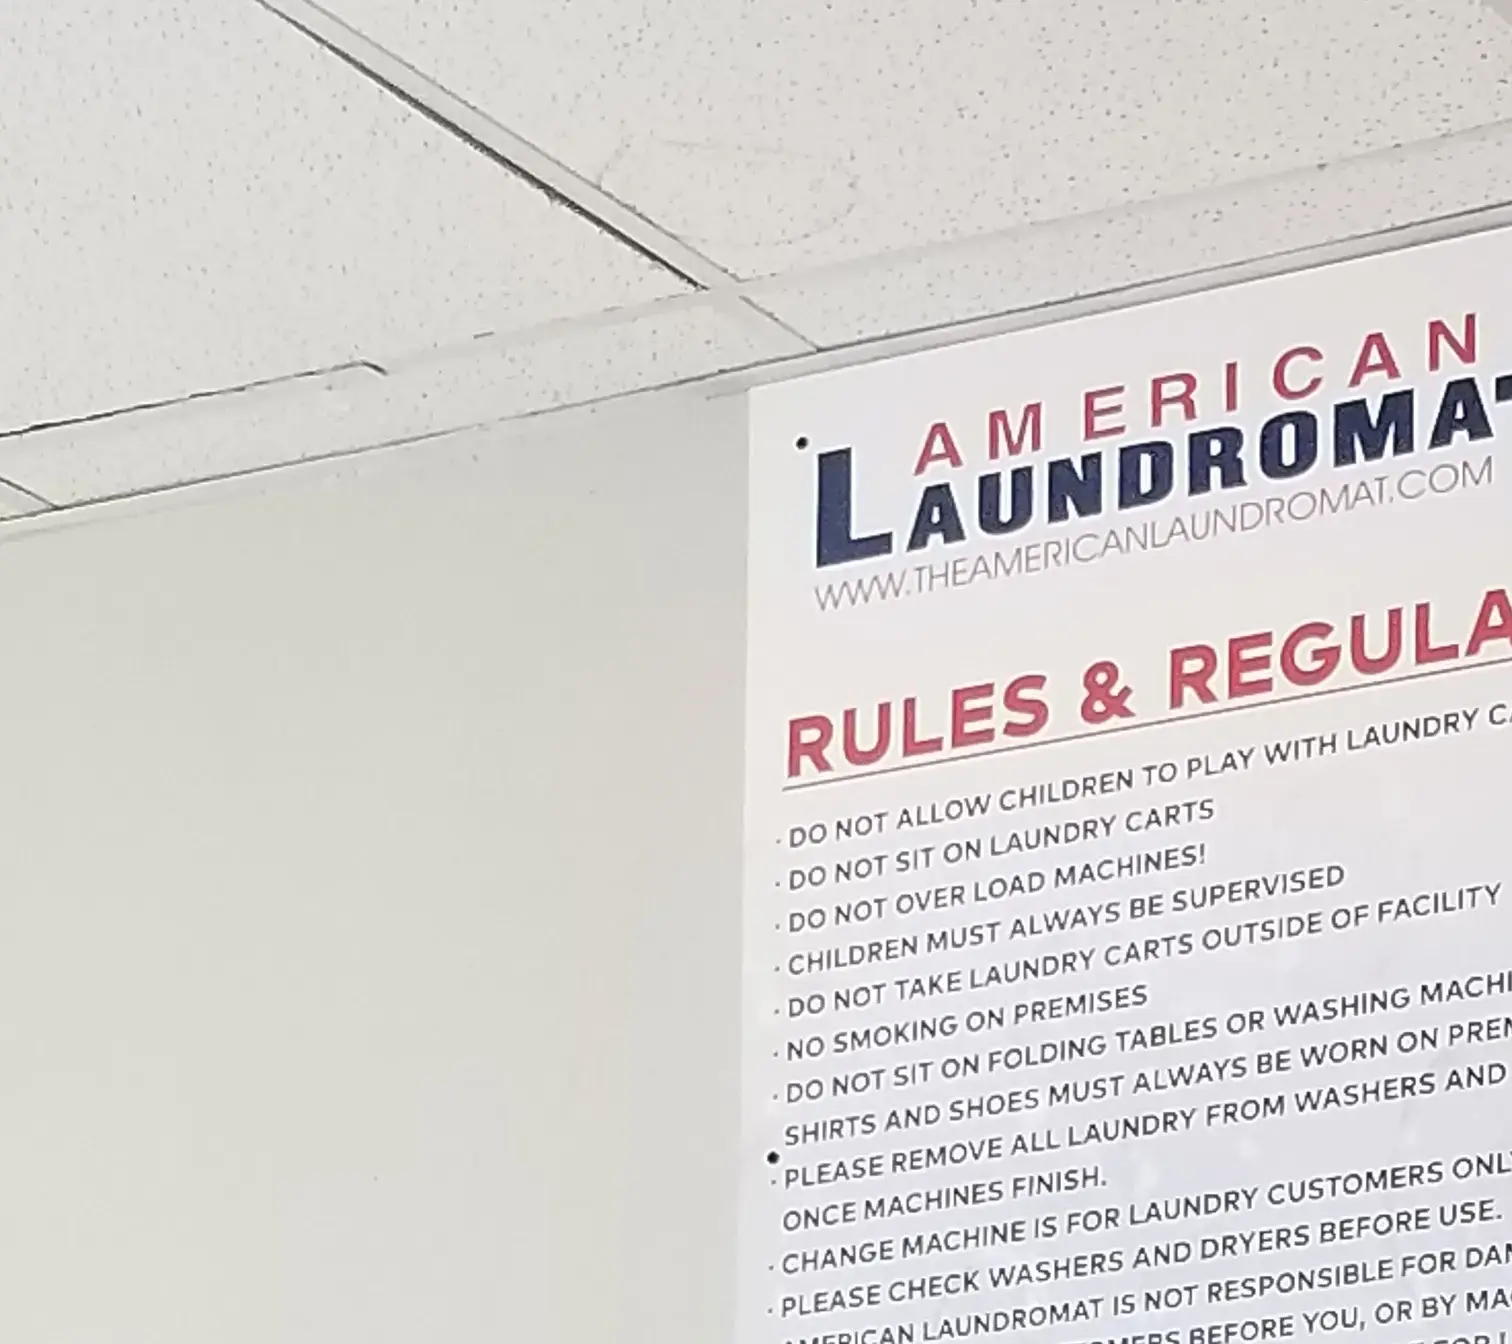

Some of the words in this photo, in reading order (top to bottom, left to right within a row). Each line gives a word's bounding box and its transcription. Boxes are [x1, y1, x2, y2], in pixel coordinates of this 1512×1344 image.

[914, 314, 1477, 475] AMERICAN
[815, 455, 1493, 612] WWW.THEAMERICANLAUNDROMAT.COM
[787, 674, 1049, 777] RULES
[1080, 660, 1131, 725] &
[788, 822, 829, 850] DO
[835, 810, 890, 842] NOT
[895, 792, 993, 831] ALLOW
[998, 767, 1134, 812] CHILDREN
[1140, 761, 1178, 787] TO
[1186, 746, 1256, 781] PLAY
[1262, 732, 1338, 766] WITH
[1346, 706, 1481, 752] LAUNDRY
[787, 934, 919, 977] CHILDREN
[925, 920, 1002, 954] MUST
[1008, 900, 1122, 941] ALWAYS
[1128, 893, 1166, 921] BE
[1171, 864, 1345, 913] SUPERVISED
[788, 907, 827, 934] DO
[833, 896, 889, 927] NOT
[894, 884, 966, 915] OVER
[973, 870, 1046, 903] LOAD
[1053, 842, 1206, 890] MACHINES!
[786, 1035, 826, 1062] NO
[832, 1014, 960, 1055] SMOKING
[964, 1005, 1005, 1034] ON
[1013, 983, 1149, 1026] PREMISES
[784, 1112, 878, 1147] SHIRTS
[883, 1103, 942, 1133] AND
[948, 1087, 1040, 1122] SHOES
[1048, 1073, 1126, 1108] MUST
[1131, 1055, 1248, 1095] ALWAYS
[1256, 1048, 1292, 1076] BE
[1299, 1033, 1389, 1069] WORN
[1395, 1026, 1440, 1055] ON
[781, 1238, 895, 1276] CHANGE
[901, 1219, 1027, 1260] MACHINE
[1033, 1215, 1058, 1240] IS
[1066, 1206, 1121, 1235] FOR
[1128, 1186, 1260, 1227] LAUNDRY
[1266, 1160, 1444, 1206] CUSTOMERS
[782, 1200, 858, 1233] ONCE
[863, 1179, 1005, 1221] MACHINES
[1011, 1164, 1108, 1200] FINISH.
[1301, 1305, 1366, 1334] YOU,
[1374, 1299, 1413, 1326] OR
[1420, 1292, 1458, 1319] BY
